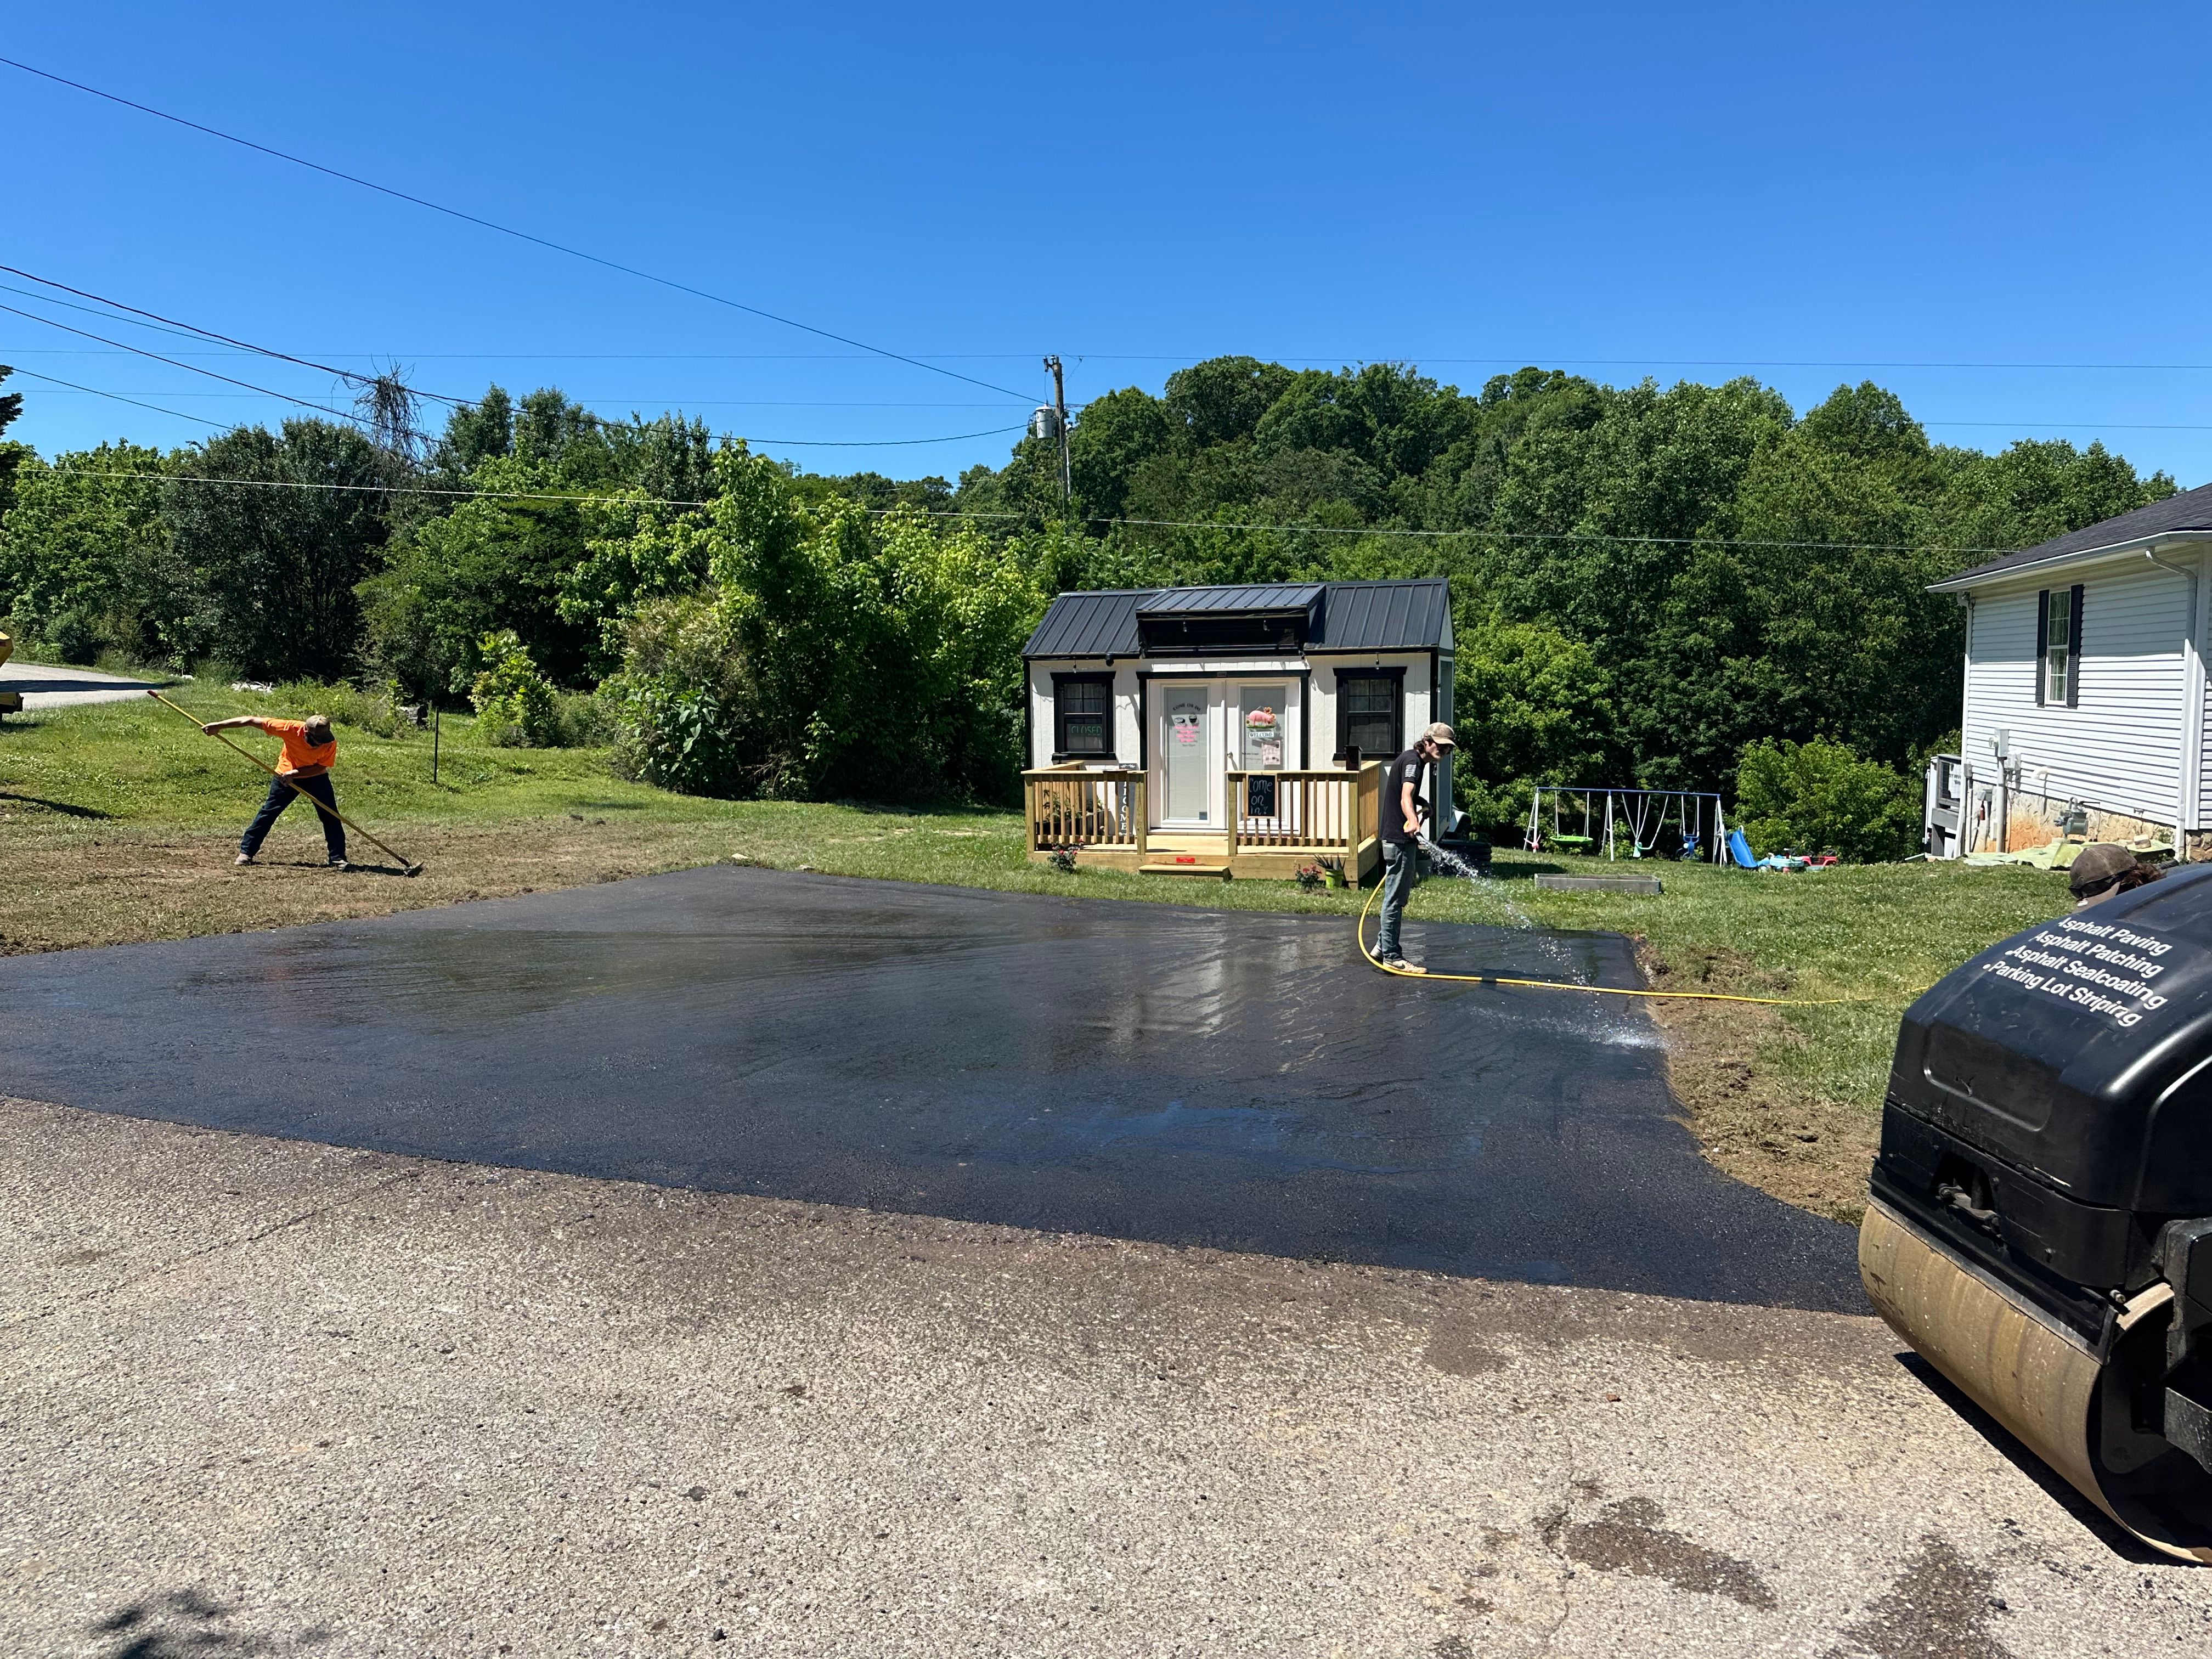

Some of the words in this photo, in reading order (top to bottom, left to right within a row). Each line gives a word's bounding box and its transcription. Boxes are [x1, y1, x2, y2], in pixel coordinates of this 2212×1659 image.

[1172, 703, 1186, 711] COME
[1071, 725, 1102, 735] CLOSED
[1249, 778, 1273, 794] Come
[1251, 795, 1264, 806] on
[2058, 917, 2115, 938] Asphalt
[2108, 928, 2172, 956] Paving
[2033, 930, 2091, 953] Asphalt
[2085, 944, 2165, 978] Patching
[2011, 945, 2068, 969] Asphalt
[2063, 960, 2168, 1010] Sealcoating
[1988, 961, 2045, 989] Parking
[2040, 977, 2074, 997] Lot
[2068, 986, 2143, 1027] Striping
